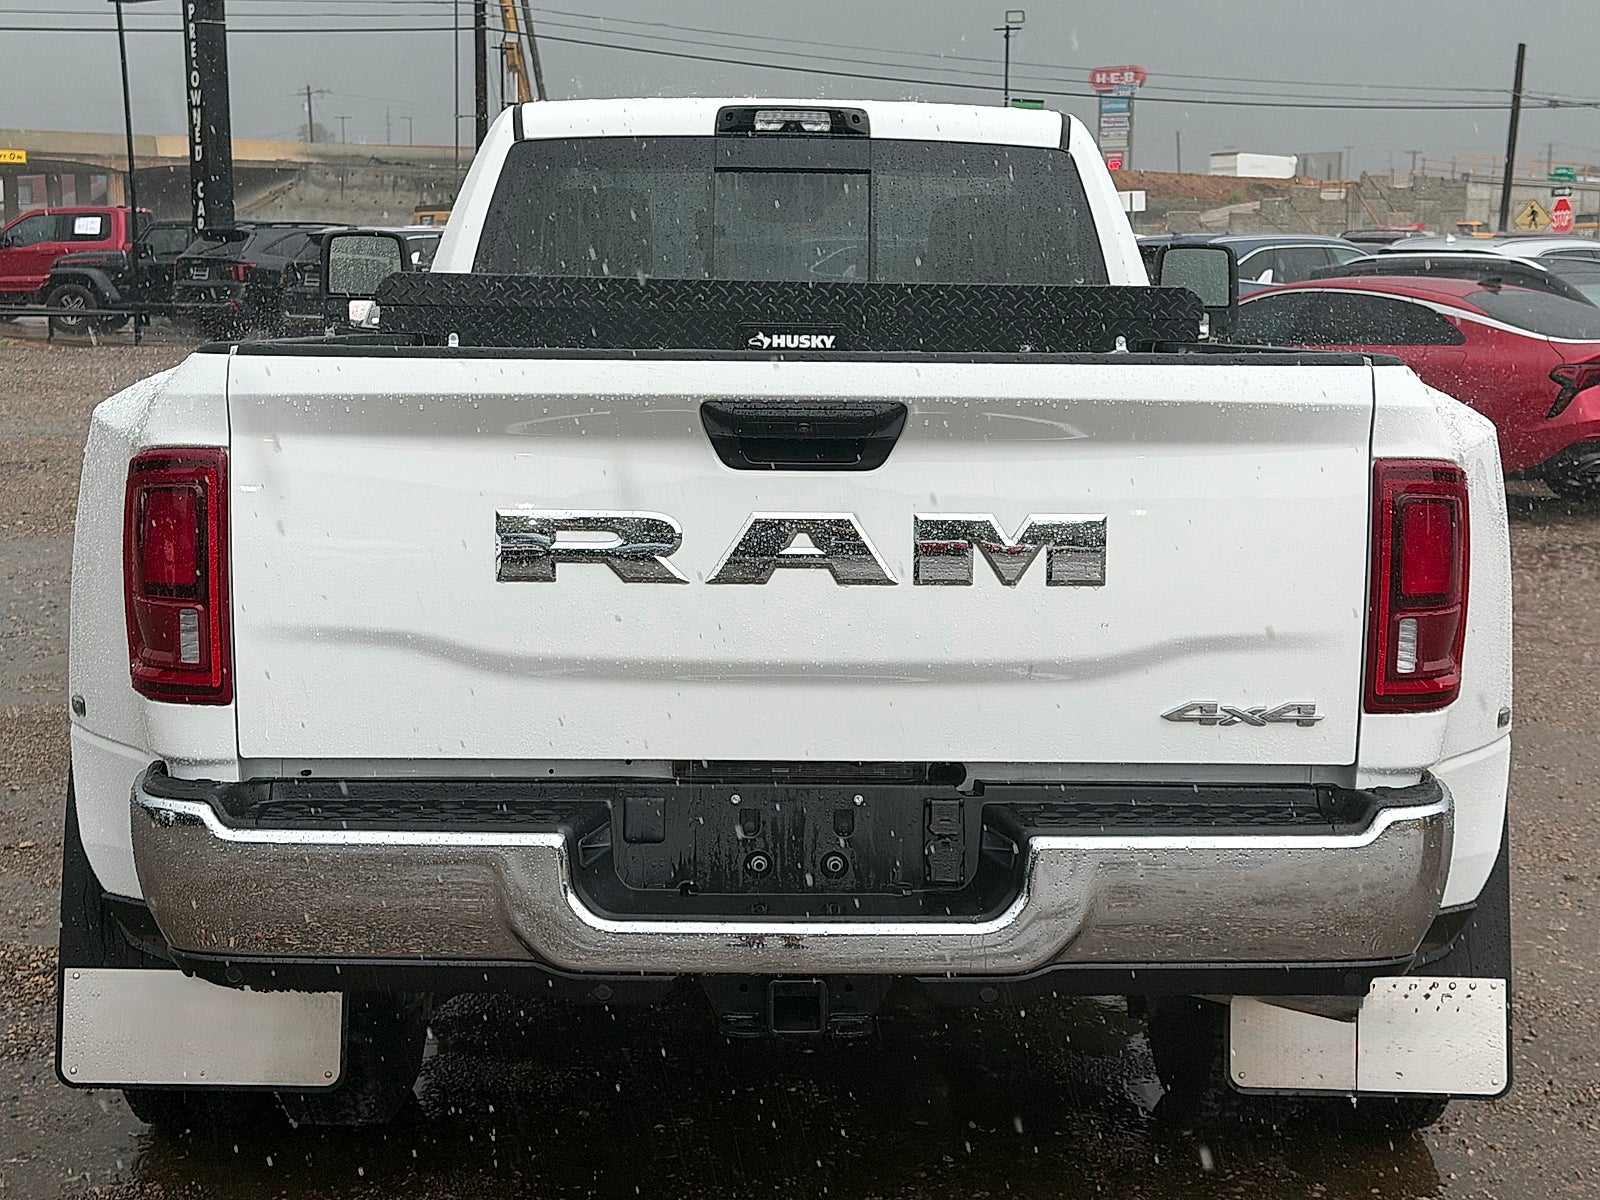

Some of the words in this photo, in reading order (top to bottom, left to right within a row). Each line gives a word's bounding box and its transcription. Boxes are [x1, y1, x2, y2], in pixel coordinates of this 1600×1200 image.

[1552, 209, 1572, 228] STOP
[772, 334, 836, 349] HUSKY
[495, 508, 1108, 586] RAM
